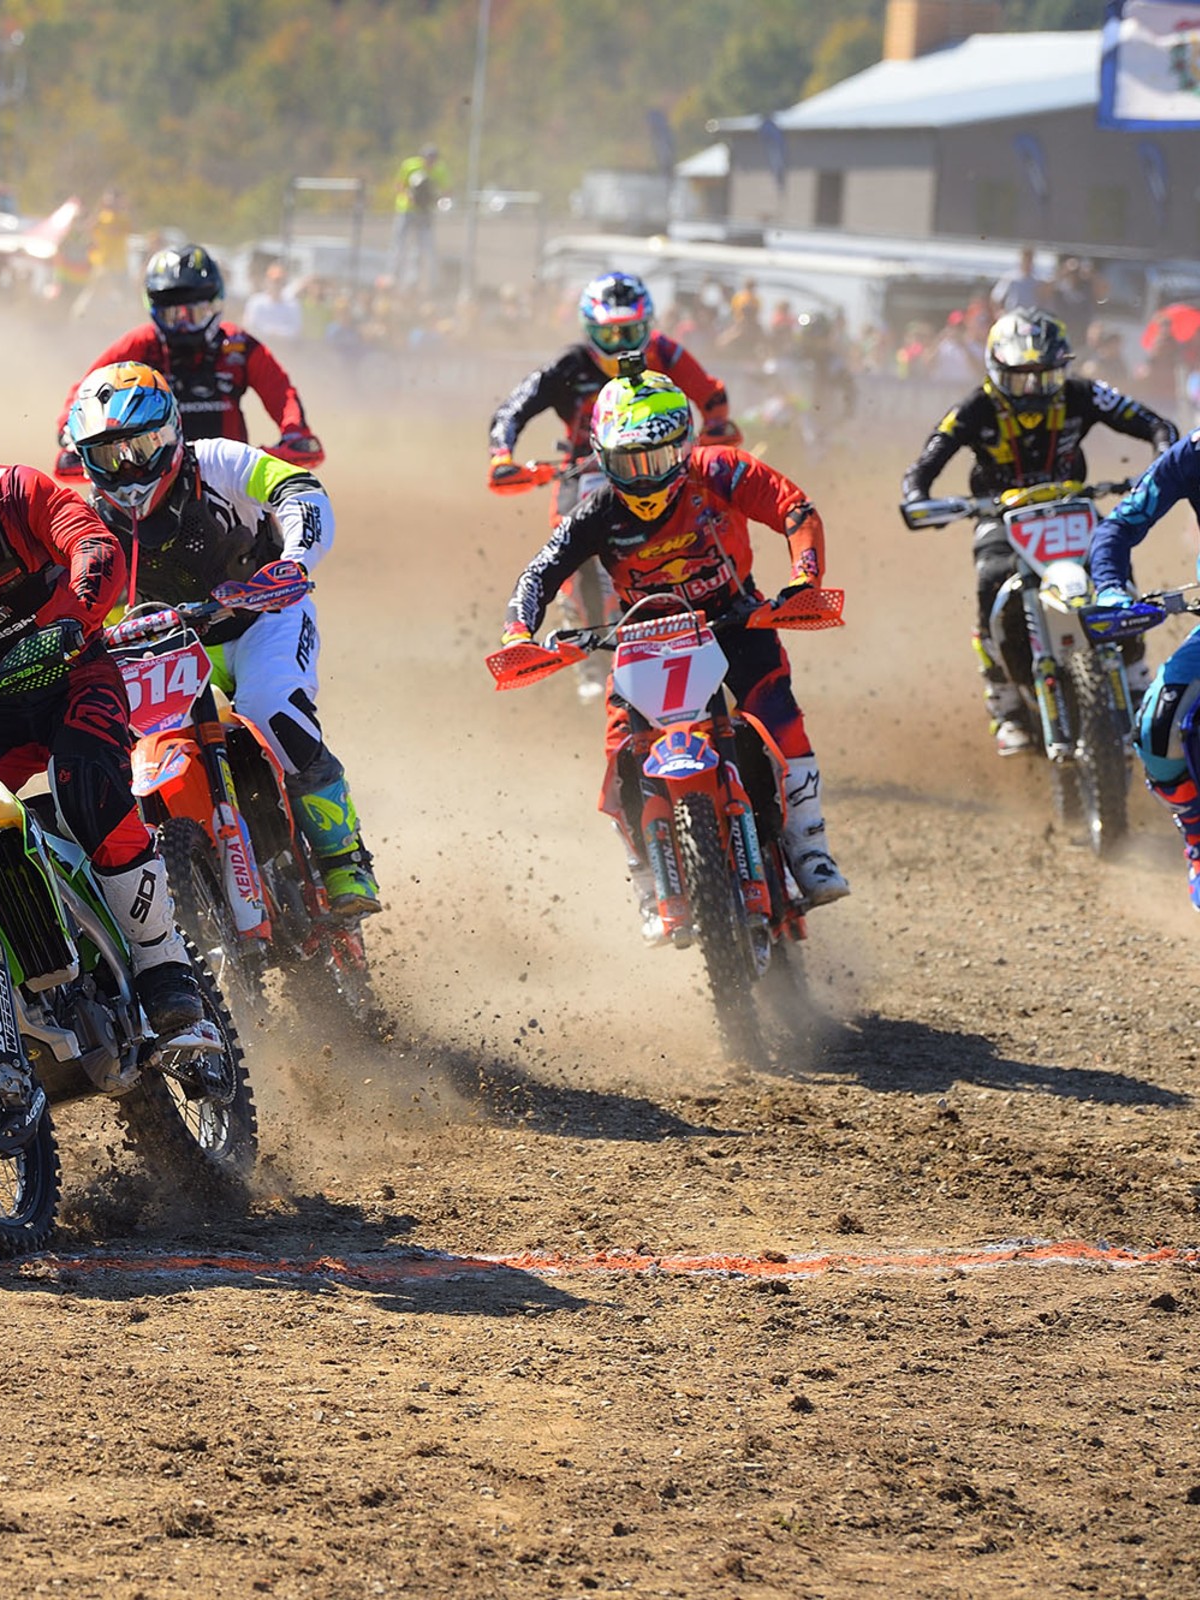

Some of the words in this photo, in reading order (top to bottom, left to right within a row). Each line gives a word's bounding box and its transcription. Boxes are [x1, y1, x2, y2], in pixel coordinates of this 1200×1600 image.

[1021, 513, 1088, 556] 739
[122, 655, 201, 712] 514
[662, 654, 693, 712] 1
[228, 842, 252, 898] KENDA
